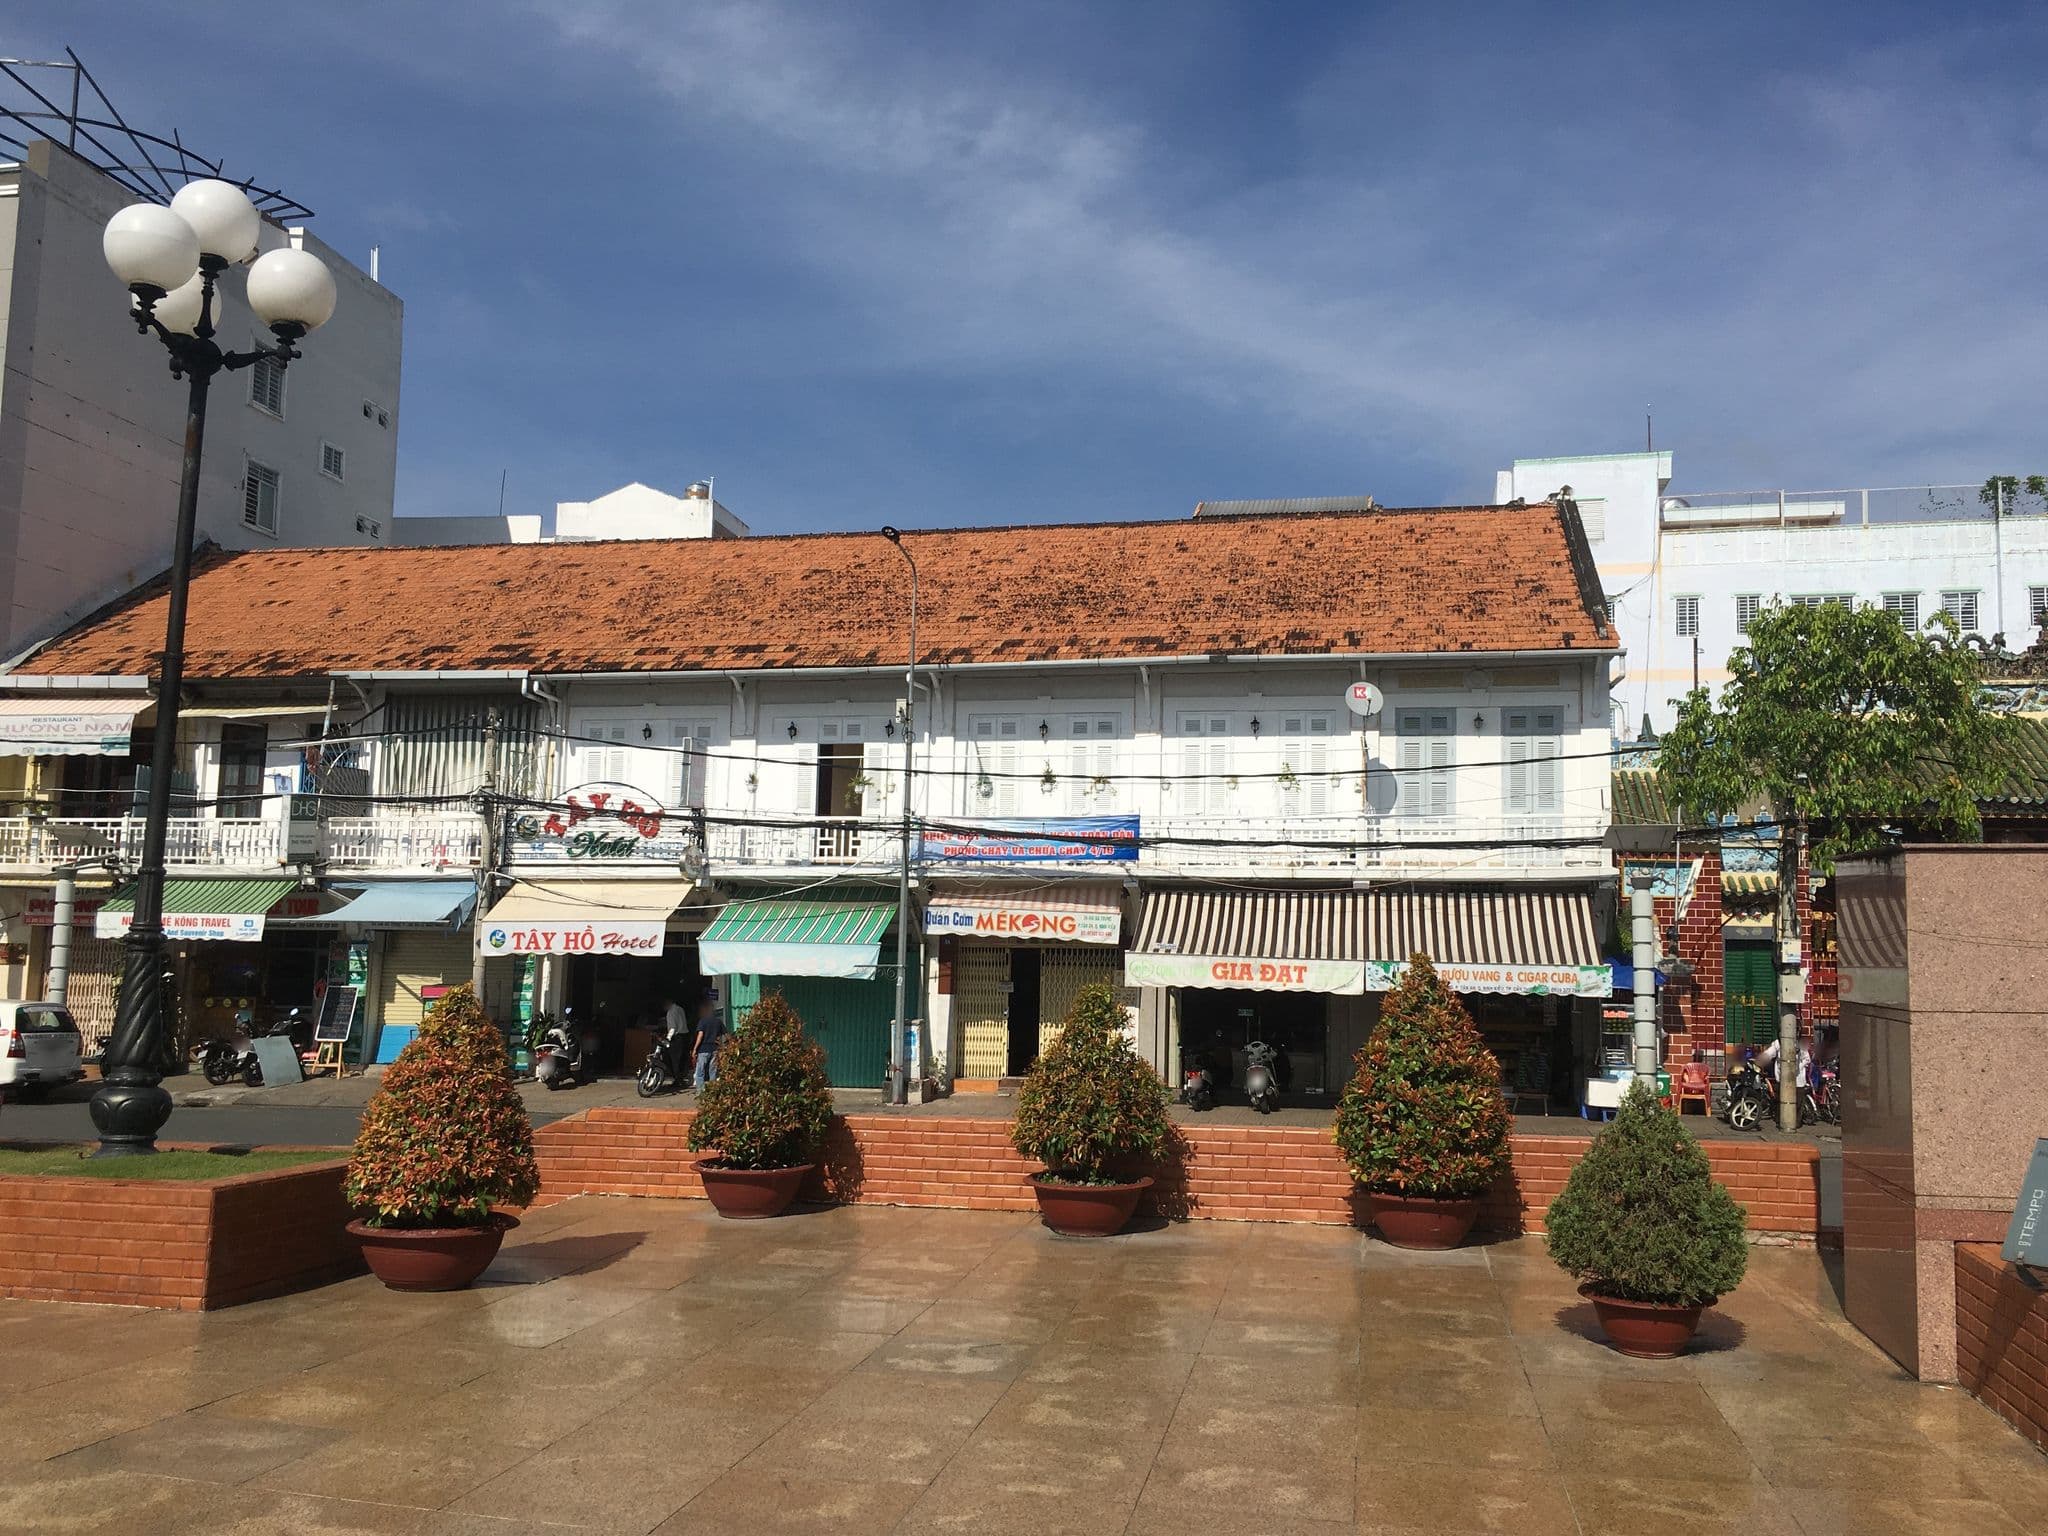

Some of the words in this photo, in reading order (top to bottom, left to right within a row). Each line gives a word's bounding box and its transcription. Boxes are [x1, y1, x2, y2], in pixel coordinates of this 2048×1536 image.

[85, 722, 131, 732] NAM
[291, 800, 317, 817] DHG
[567, 831, 640, 857] Hotel
[174, 915, 199, 927] KÔNG
[201, 917, 232, 928] TRAVEL
[208, 929, 225, 937] Shop
[511, 928, 556, 950] TÂY
[564, 925, 595, 950] HỒ
[601, 932, 659, 949] Hotel
[1212, 962, 1253, 982] GIA
[1259, 964, 1307, 986] ĐẠT
[1441, 968, 1469, 983] RƯỢU
[1473, 971, 1500, 982] VANG
[1505, 971, 1513, 982] &
[1518, 971, 1548, 982] CIGAR
[1551, 972, 1578, 983] CUBA
